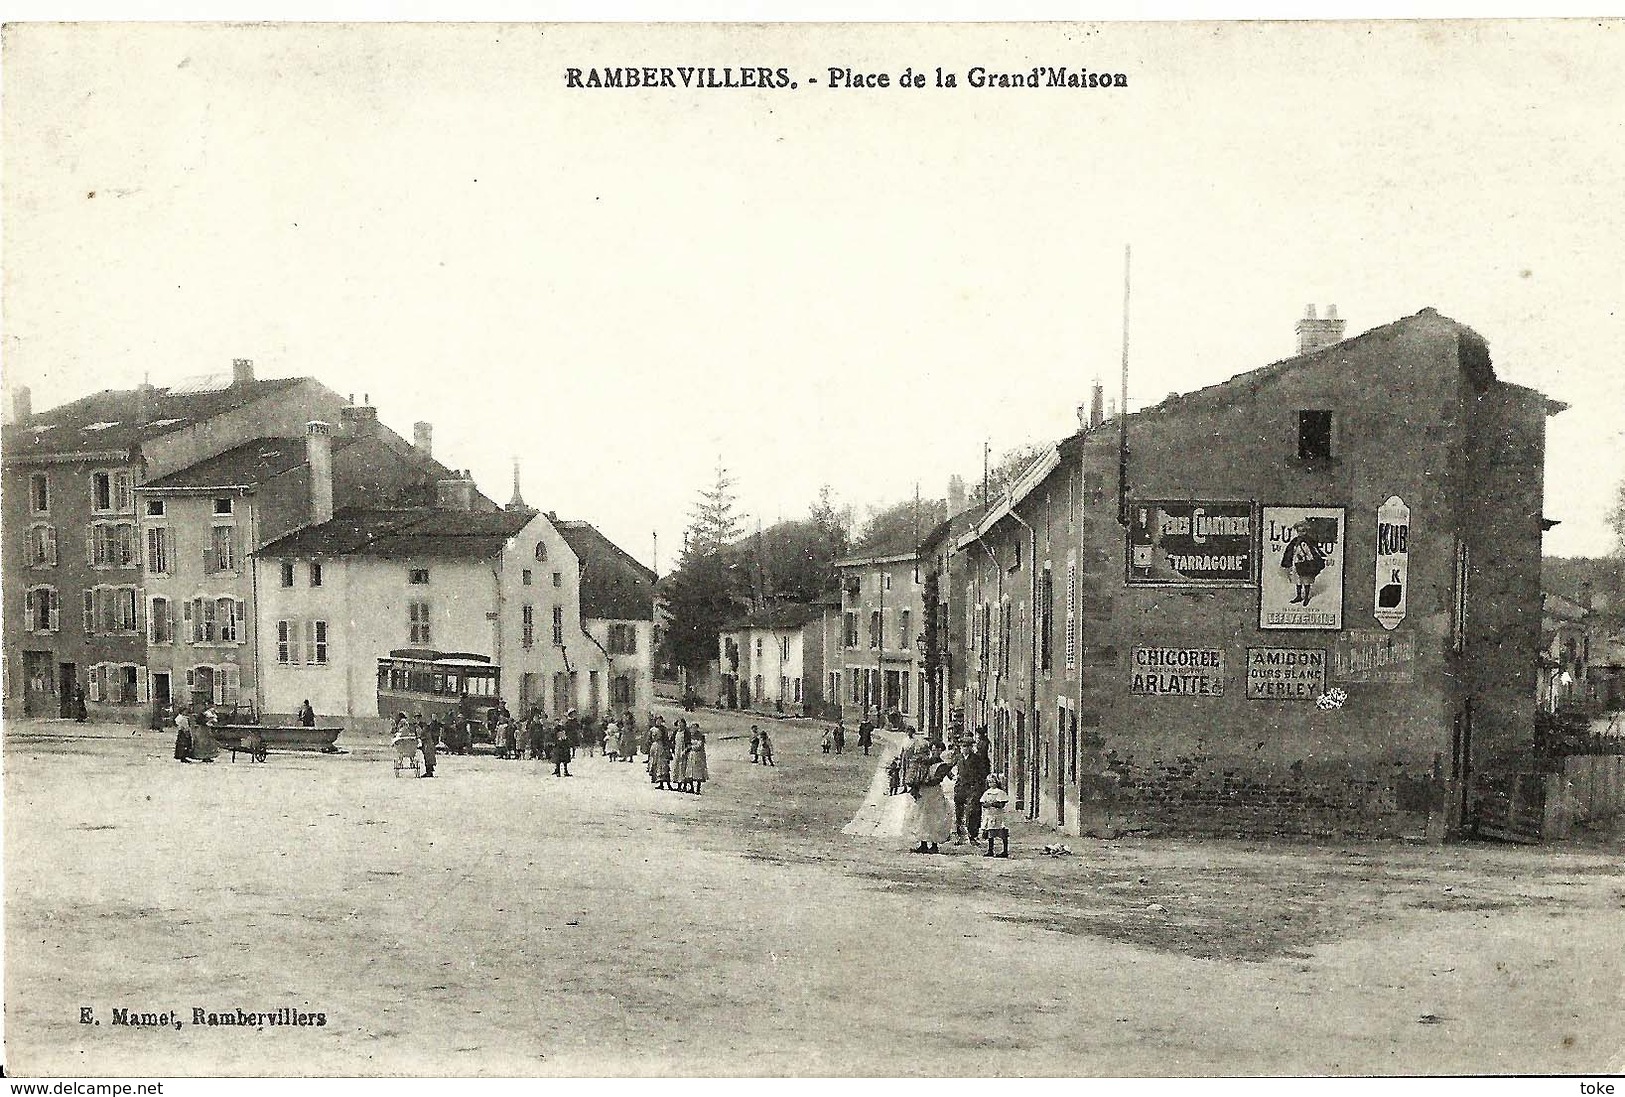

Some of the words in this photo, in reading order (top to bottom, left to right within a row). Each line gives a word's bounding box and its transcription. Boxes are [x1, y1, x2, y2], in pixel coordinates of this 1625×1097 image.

[1378, 523, 1408, 556] KUB
[1391, 568, 1402, 583] K
[1253, 652, 1323, 666] AMIDON
[1251, 668, 1282, 679] OURS
[1284, 669, 1322, 680] BLANC
[1132, 673, 1210, 694] ARLATTE
[1255, 682, 1316, 696] VERLEY
